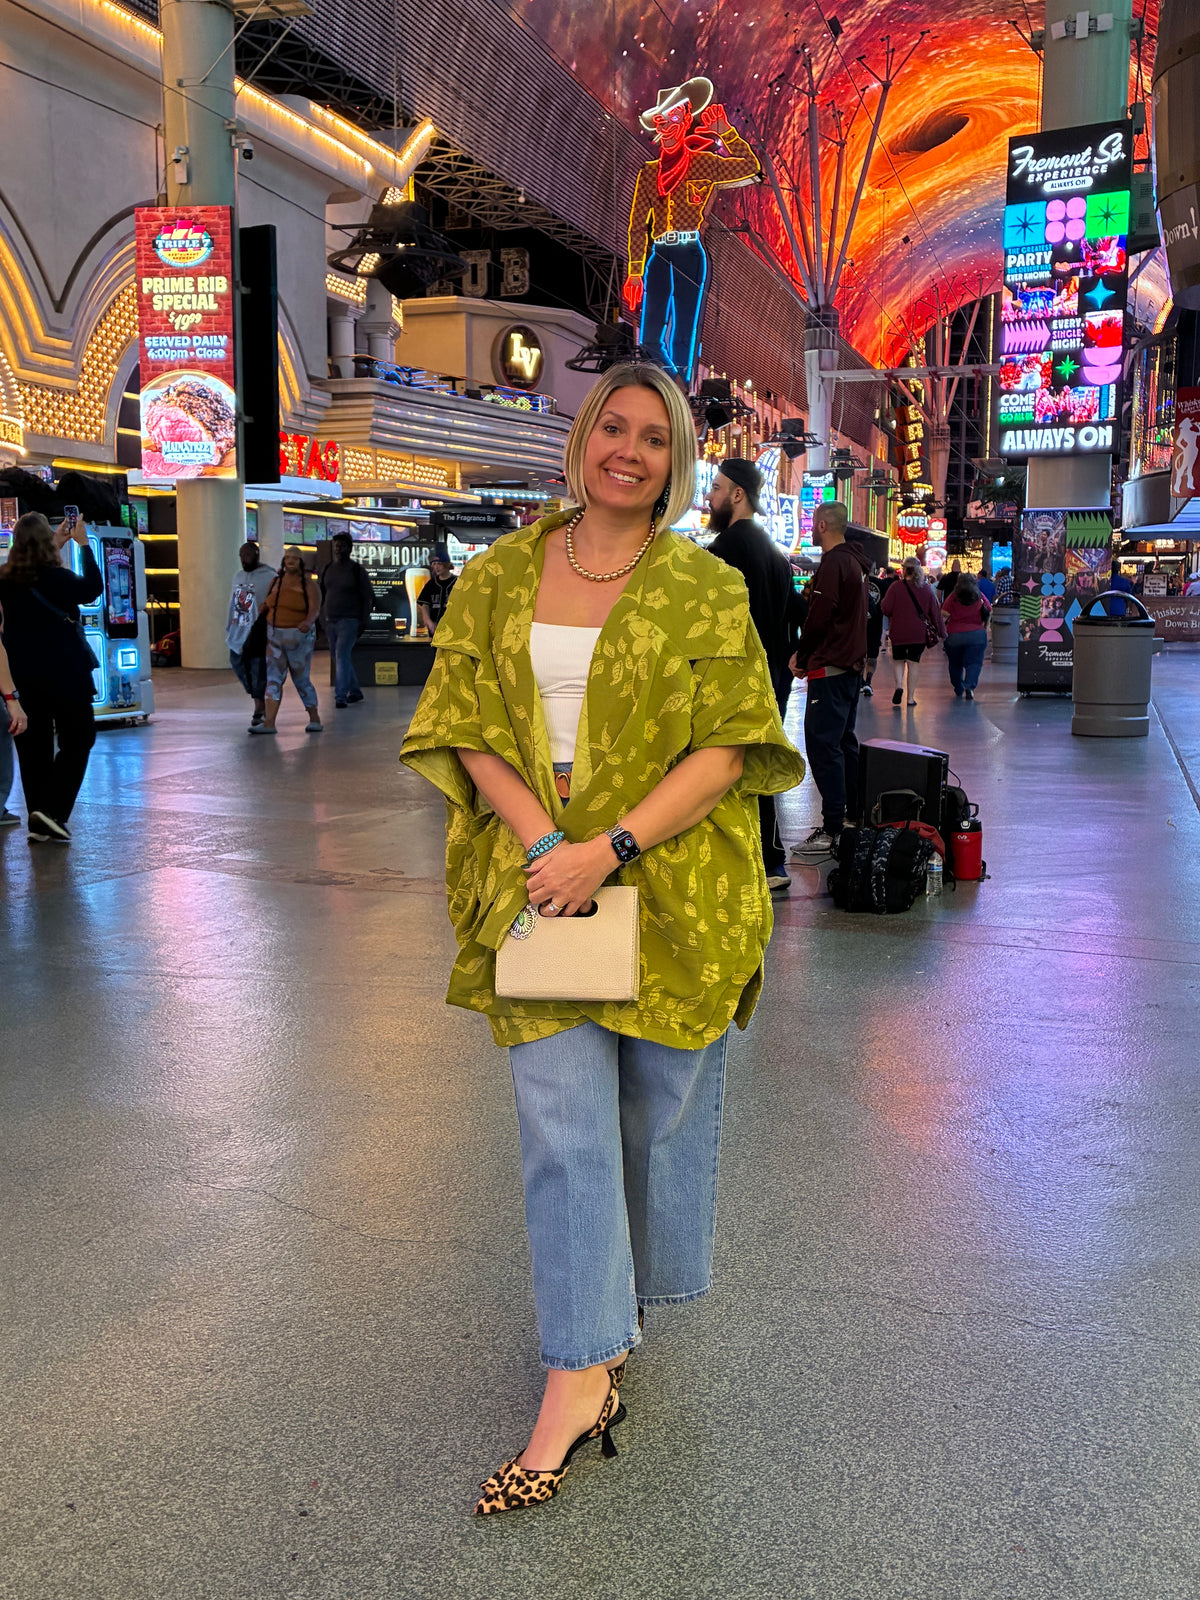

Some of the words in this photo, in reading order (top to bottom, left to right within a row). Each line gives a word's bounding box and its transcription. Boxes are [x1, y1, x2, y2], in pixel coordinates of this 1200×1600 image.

[1011, 145, 1092, 177] Fremont
[1093, 131, 1127, 163] St.
[1027, 164, 1108, 183] EXPERIENCE
[1051, 180, 1074, 189] ALWAYS
[155, 239, 201, 249] TRIPLE
[1007, 251, 1053, 268] PARTY
[141, 277, 195, 294] PRIME
[196, 276, 228, 293] RIB
[152, 294, 218, 311] SPECIAL
[145, 335, 191, 348] SERVED
[192, 335, 228, 347] DAILY
[147, 348, 189, 360] 4:00pm
[195, 348, 226, 359] Close
[1000, 393, 1035, 406] COME
[1002, 428, 1075, 450] ALWAYS
[1078, 425, 1113, 446] ON
[456, 515, 486, 523] Fragrance
[486, 514, 496, 522] Bar
[898, 515, 929, 529] HOTEL
[350, 545, 386, 565] APPY
[391, 546, 430, 566] HOUR
[1165, 619, 1189, 628] Down
[1038, 645, 1073, 658] Fremont
